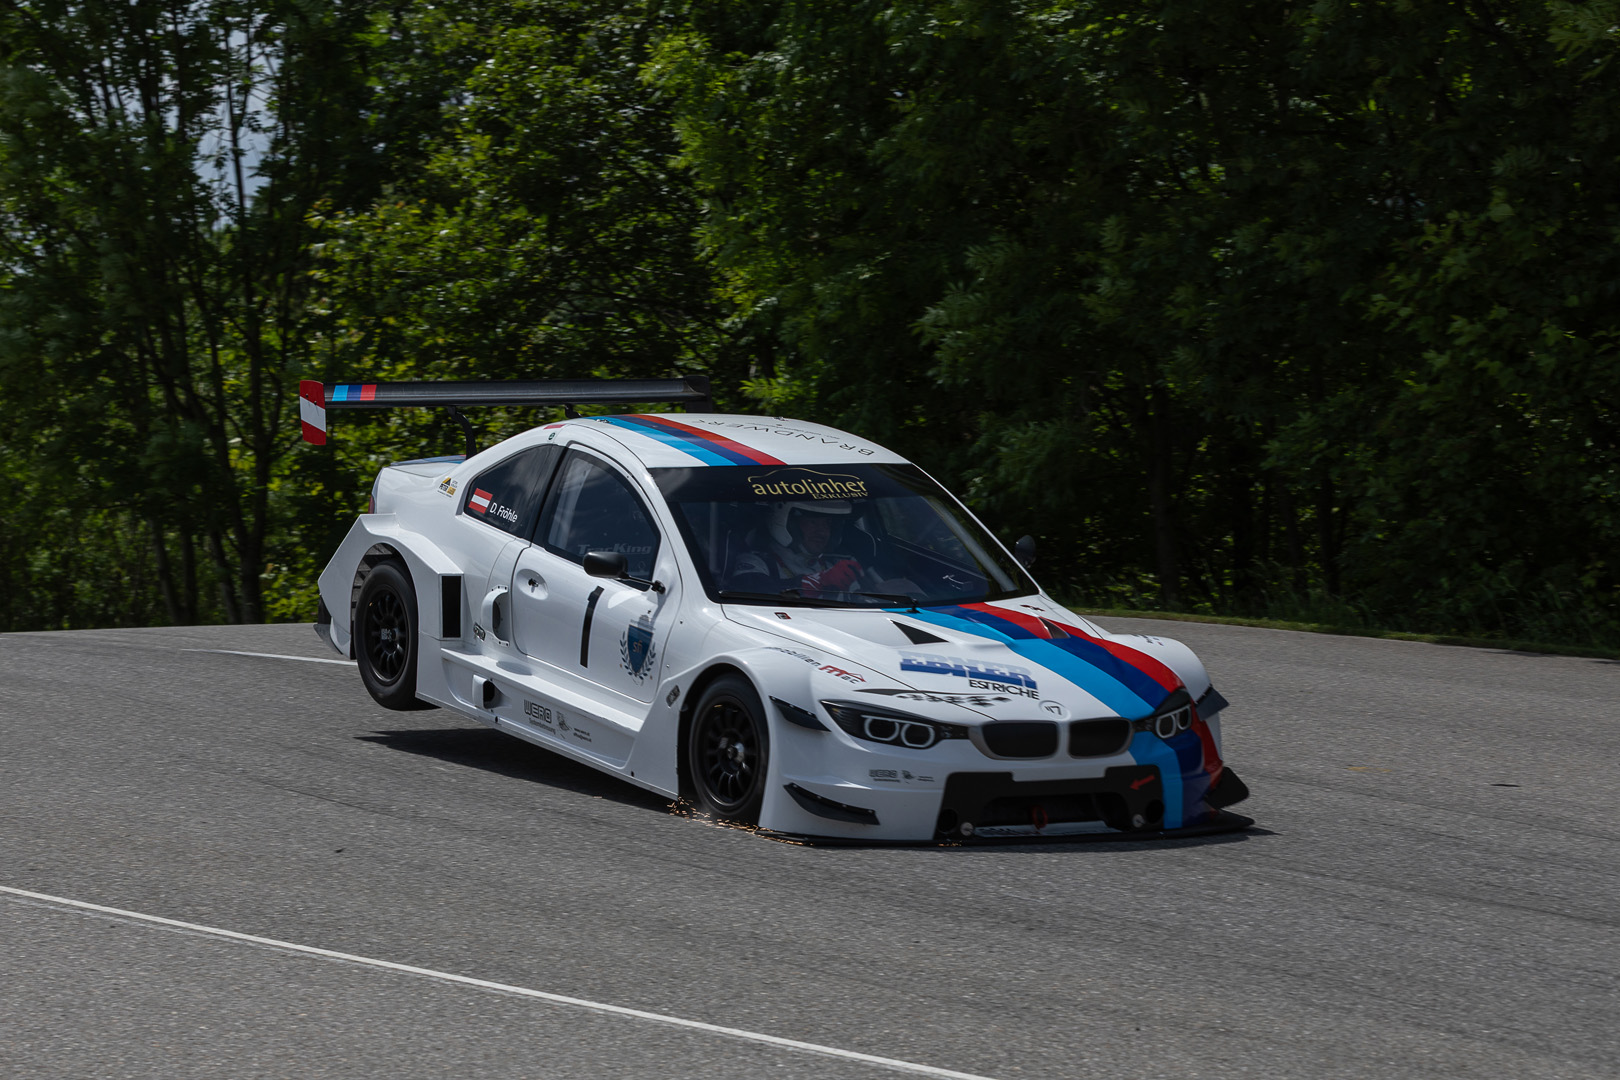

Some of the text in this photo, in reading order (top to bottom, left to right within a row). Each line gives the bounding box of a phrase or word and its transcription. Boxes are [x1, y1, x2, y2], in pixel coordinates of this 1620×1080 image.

[751, 478, 867, 495] autolinher
[812, 491, 868, 499] EXKLUSIV
[489, 502, 497, 515] D.
[968, 679, 1040, 700] ESTRICHE
